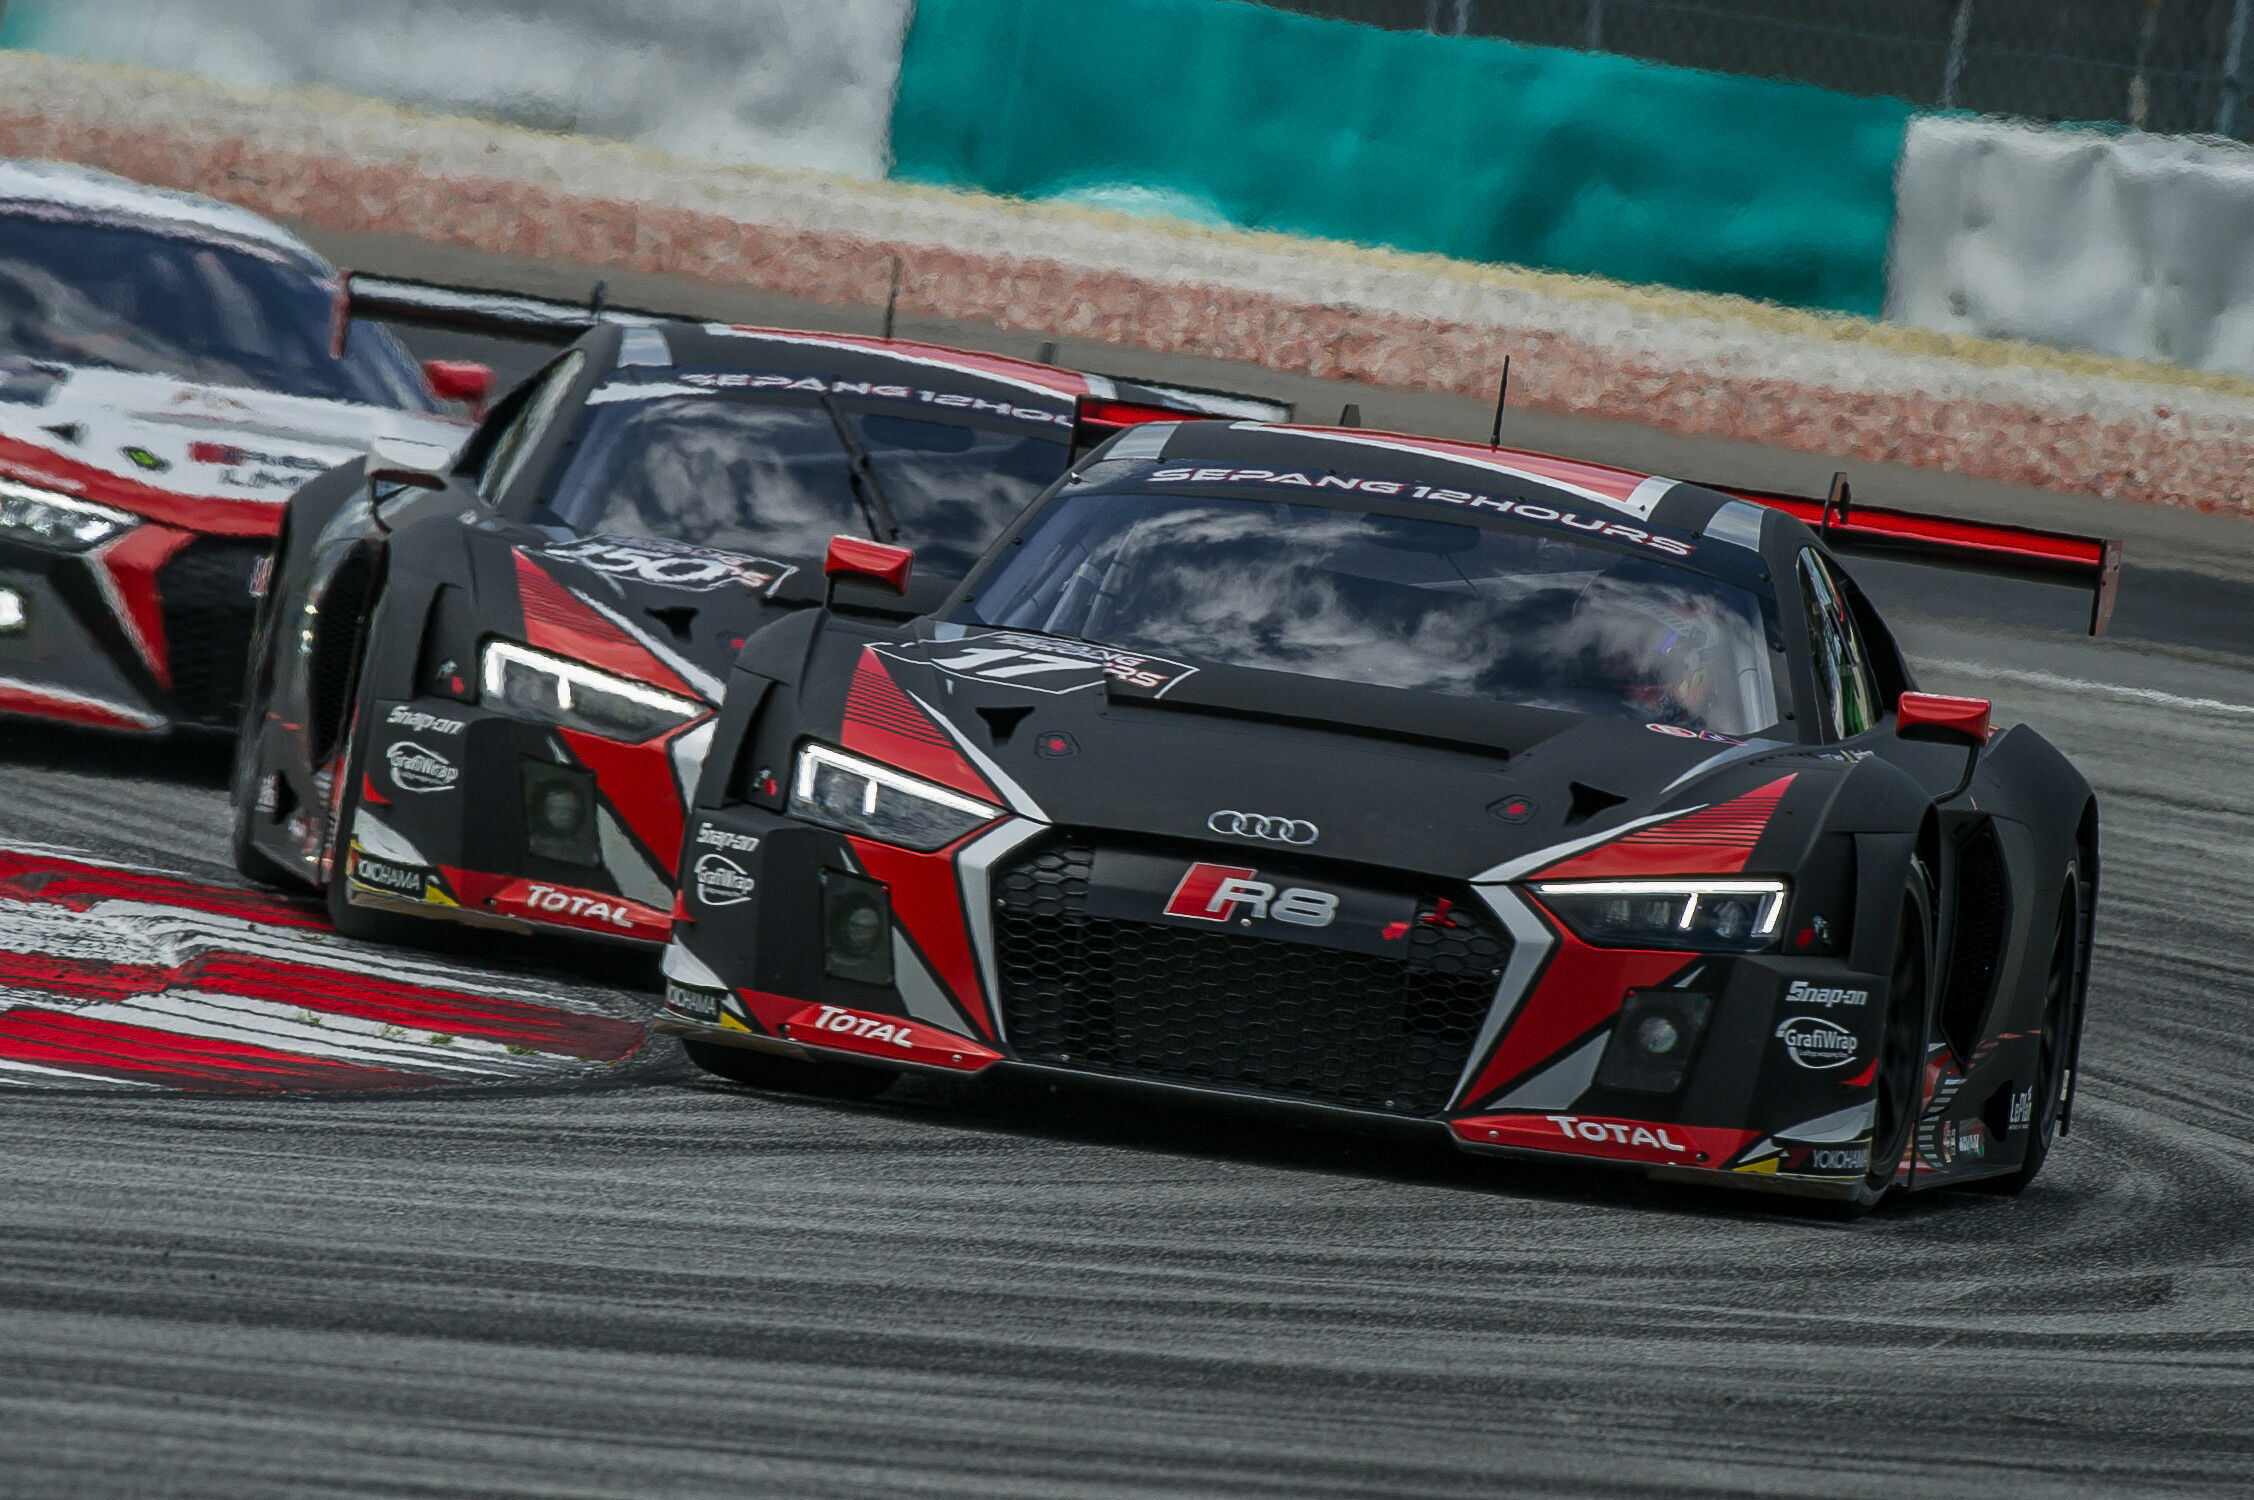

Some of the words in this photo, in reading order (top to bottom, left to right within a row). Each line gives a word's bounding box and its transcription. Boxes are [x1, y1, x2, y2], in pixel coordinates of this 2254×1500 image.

[679, 372, 909, 399] SEPANG
[918, 389, 1073, 427] 12HO
[1145, 468, 1403, 496] SEPANG
[1411, 485, 1698, 557] 12HOURS
[930, 648, 1103, 679] 17
[386, 704, 466, 735] Snap-on
[526, 883, 634, 929] TOTAL
[1204, 877, 1340, 928] R8
[1785, 980, 1868, 1008] Snap-on
[815, 1004, 914, 1048] TOTAL
[1784, 1028, 1858, 1054] GrafiWrap
[1545, 1115, 1686, 1152] TOTAL
